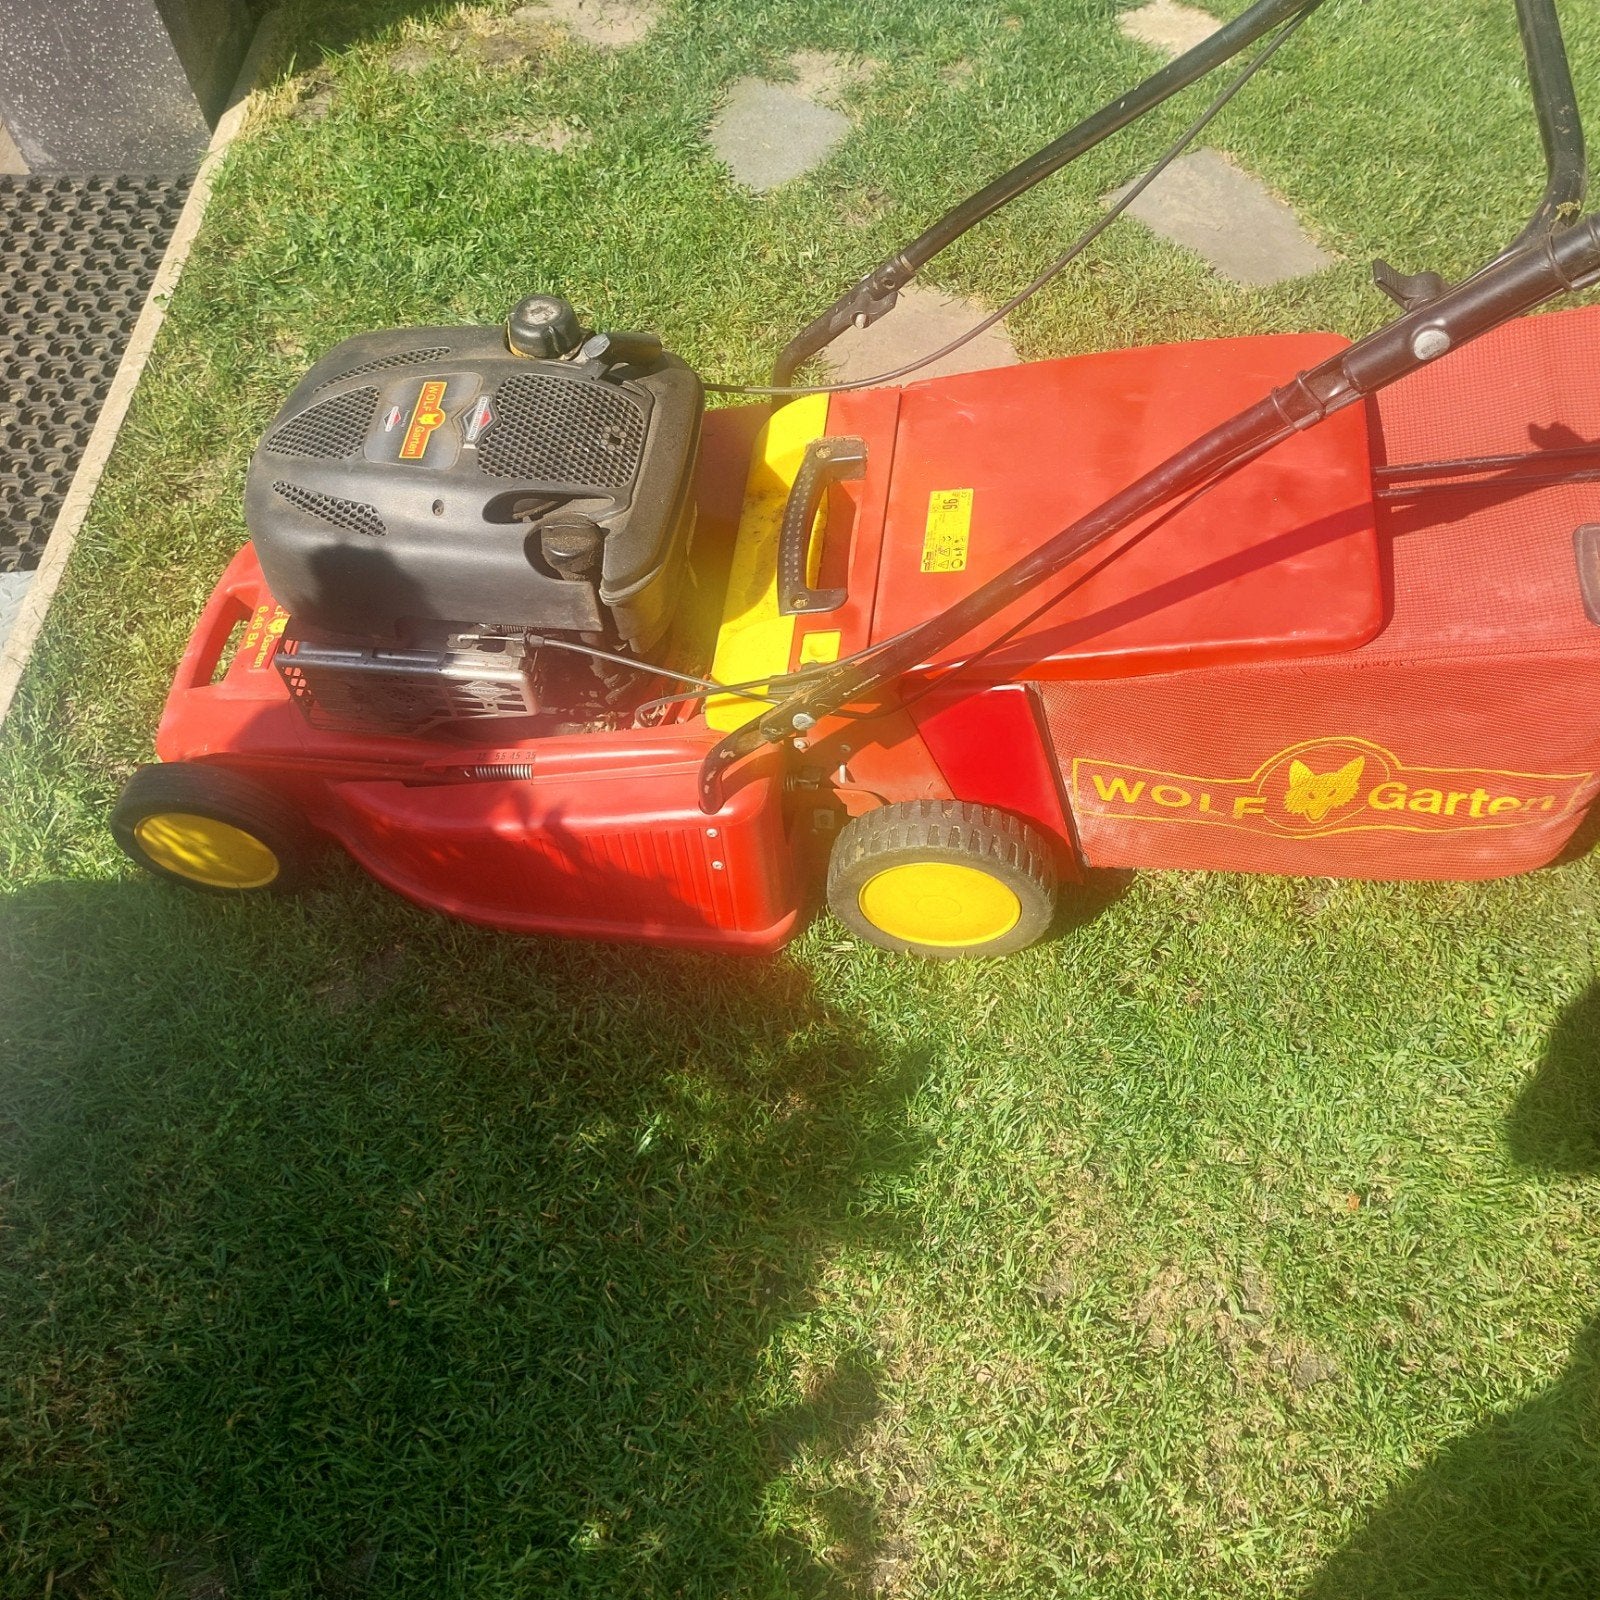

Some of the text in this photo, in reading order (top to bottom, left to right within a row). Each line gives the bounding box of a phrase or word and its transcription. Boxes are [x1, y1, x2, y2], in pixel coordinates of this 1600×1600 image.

[407, 385, 439, 455] WOLF Garten
[942, 498, 958, 510] 96
[244, 632, 259, 650] BA
[254, 634, 275, 668] Garten
[1092, 775, 1556, 819] WOLF Garten
